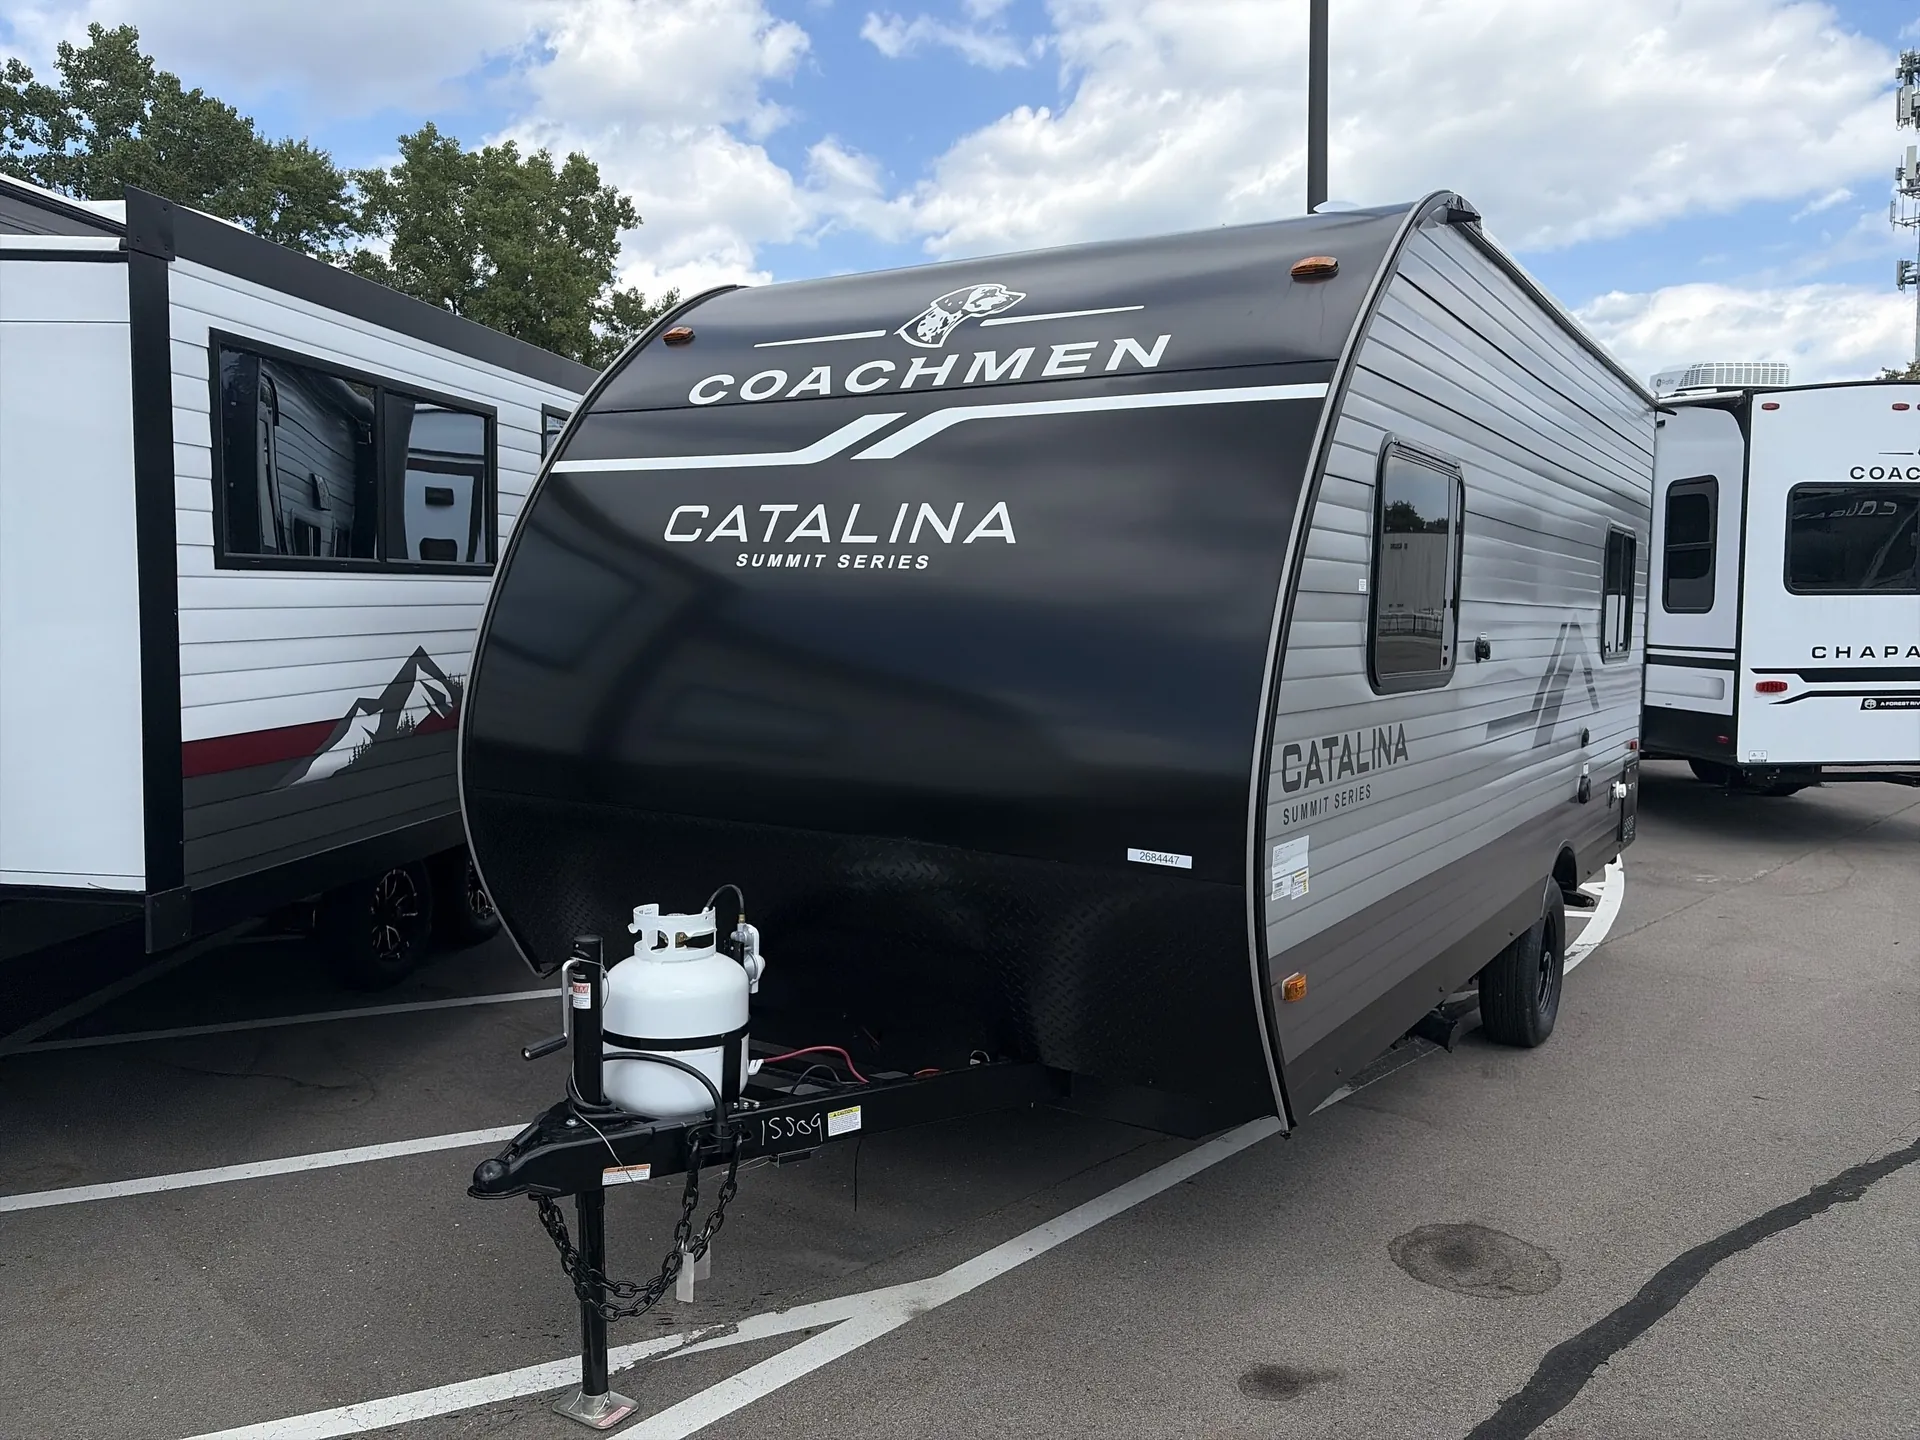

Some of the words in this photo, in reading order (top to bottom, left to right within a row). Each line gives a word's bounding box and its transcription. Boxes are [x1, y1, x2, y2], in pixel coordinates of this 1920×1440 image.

[688, 334, 1172, 405] COACHMEN
[1849, 466, 1920, 480] COAC
[663, 501, 1016, 545] CATALINA
[735, 553, 827, 569] SUMMIT
[836, 554, 929, 570] SERIES
[1811, 645, 1920, 659] CHAPA
[1282, 723, 1409, 793] CATALINA
[1283, 796, 1329, 825] SUMMIT
[1334, 784, 1371, 809] SERIES
[1139, 851, 1180, 865] 2684447
